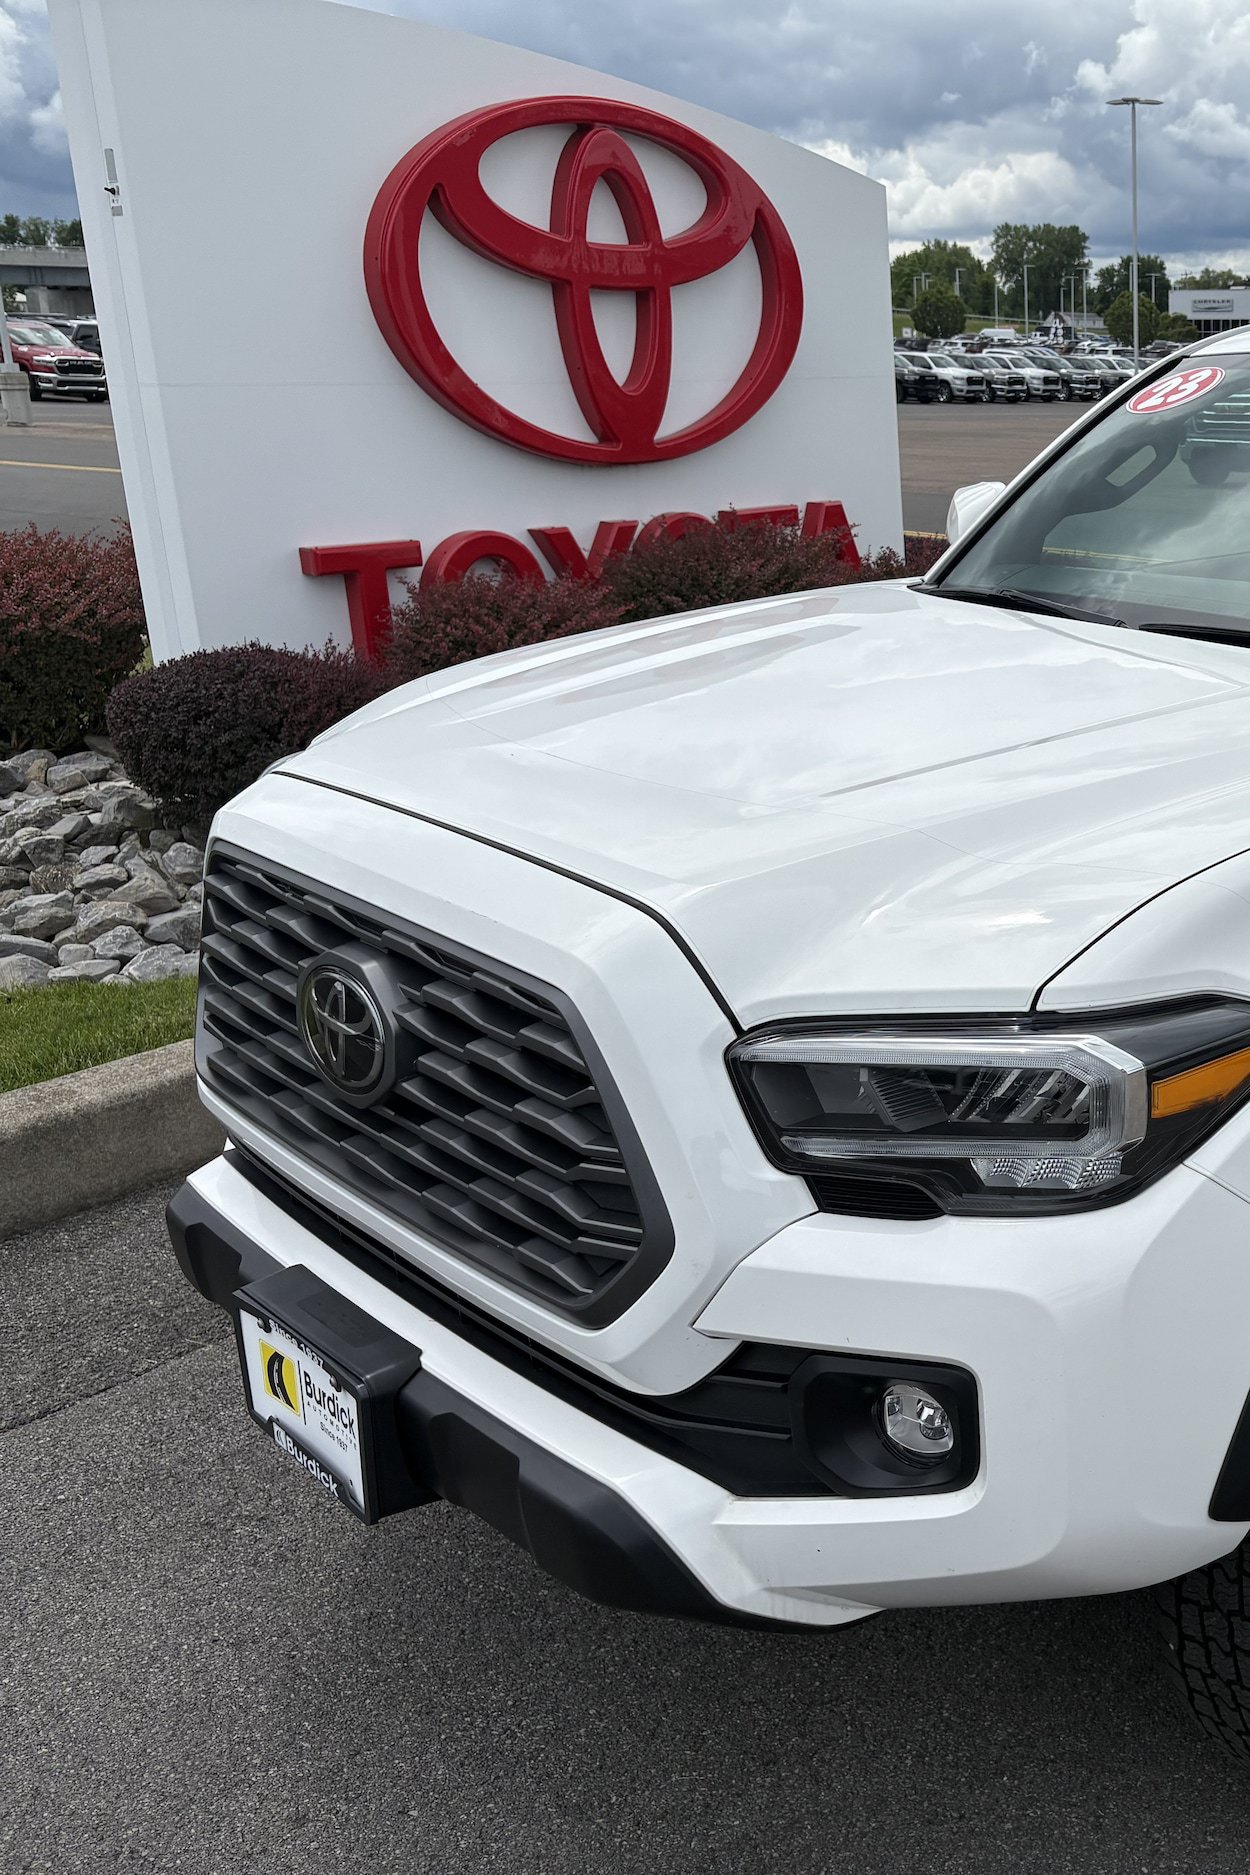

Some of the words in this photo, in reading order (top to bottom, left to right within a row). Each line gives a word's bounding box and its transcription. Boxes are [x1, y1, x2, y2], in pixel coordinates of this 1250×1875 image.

[1136, 368, 1213, 411] 23
[299, 500, 863, 668] TOYA
[268, 1318, 299, 1348] Since
[299, 1342, 325, 1368] 1937
[303, 1370, 356, 1440] Burdick
[288, 1437, 340, 1498] Burdick
